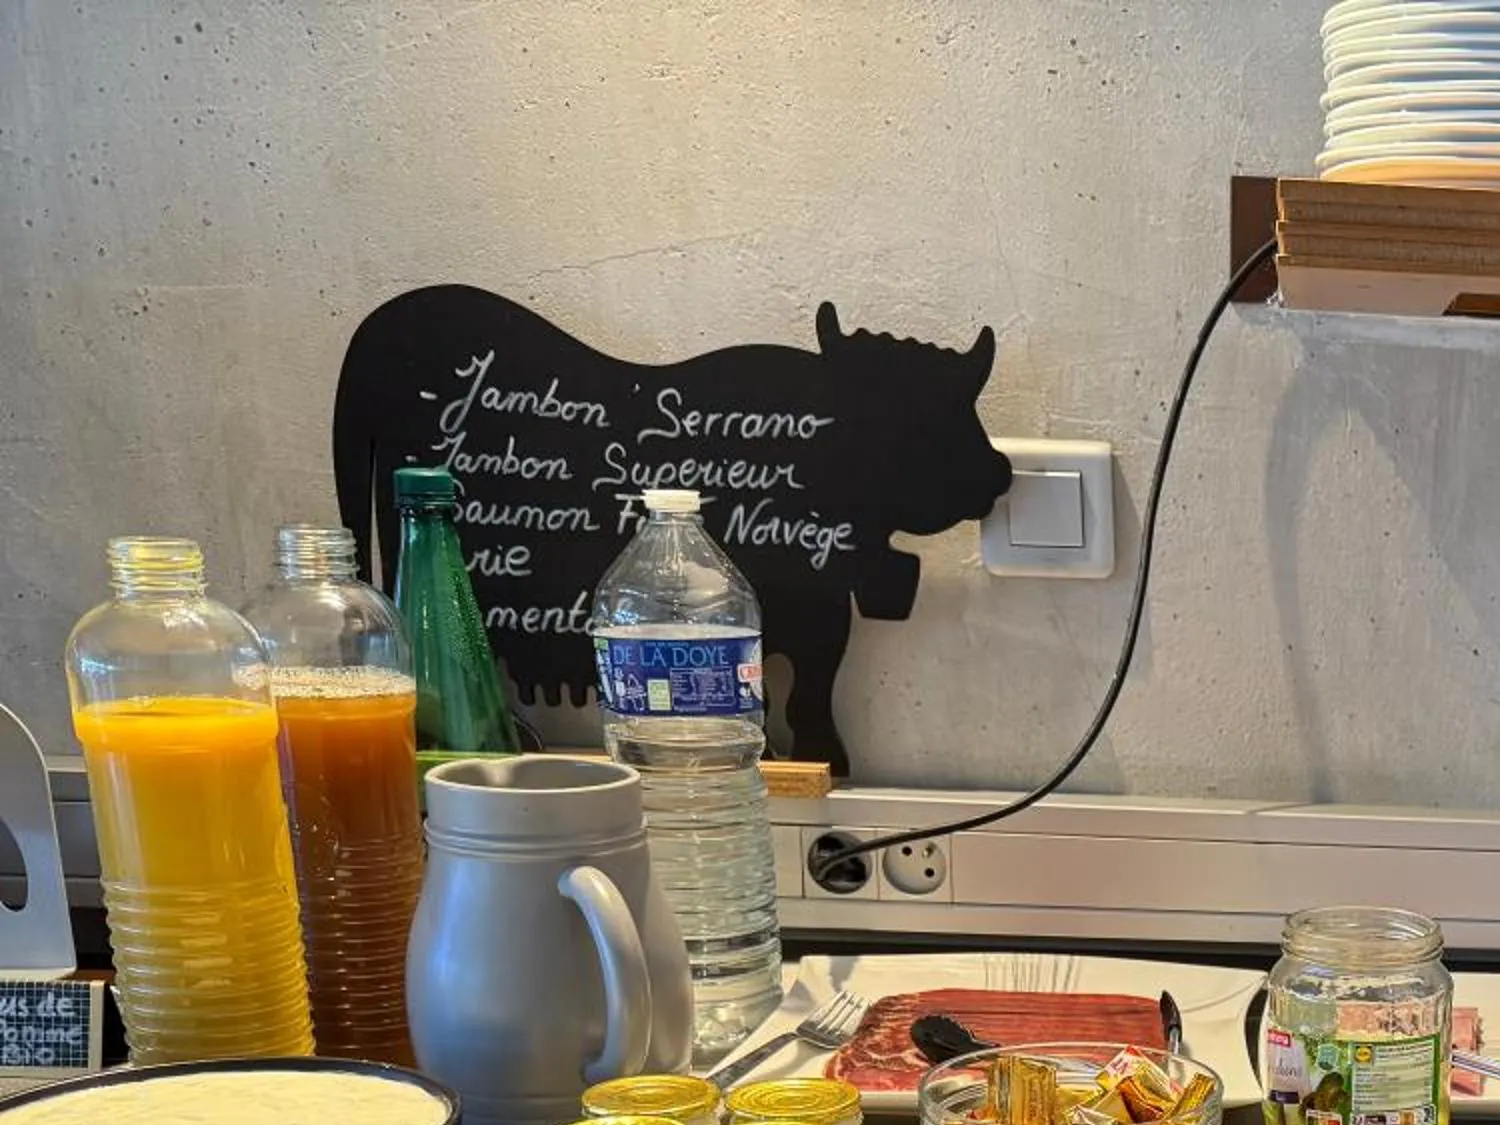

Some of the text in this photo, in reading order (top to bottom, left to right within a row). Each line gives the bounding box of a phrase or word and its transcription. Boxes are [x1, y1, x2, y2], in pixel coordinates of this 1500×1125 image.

[439, 349, 835, 443] Jambon Serrano
[723, 497, 857, 571] Norvège
[464, 544, 534, 577] rie
[613, 644, 730, 668] DE LA DOYE
[0, 990, 76, 1017] us de
